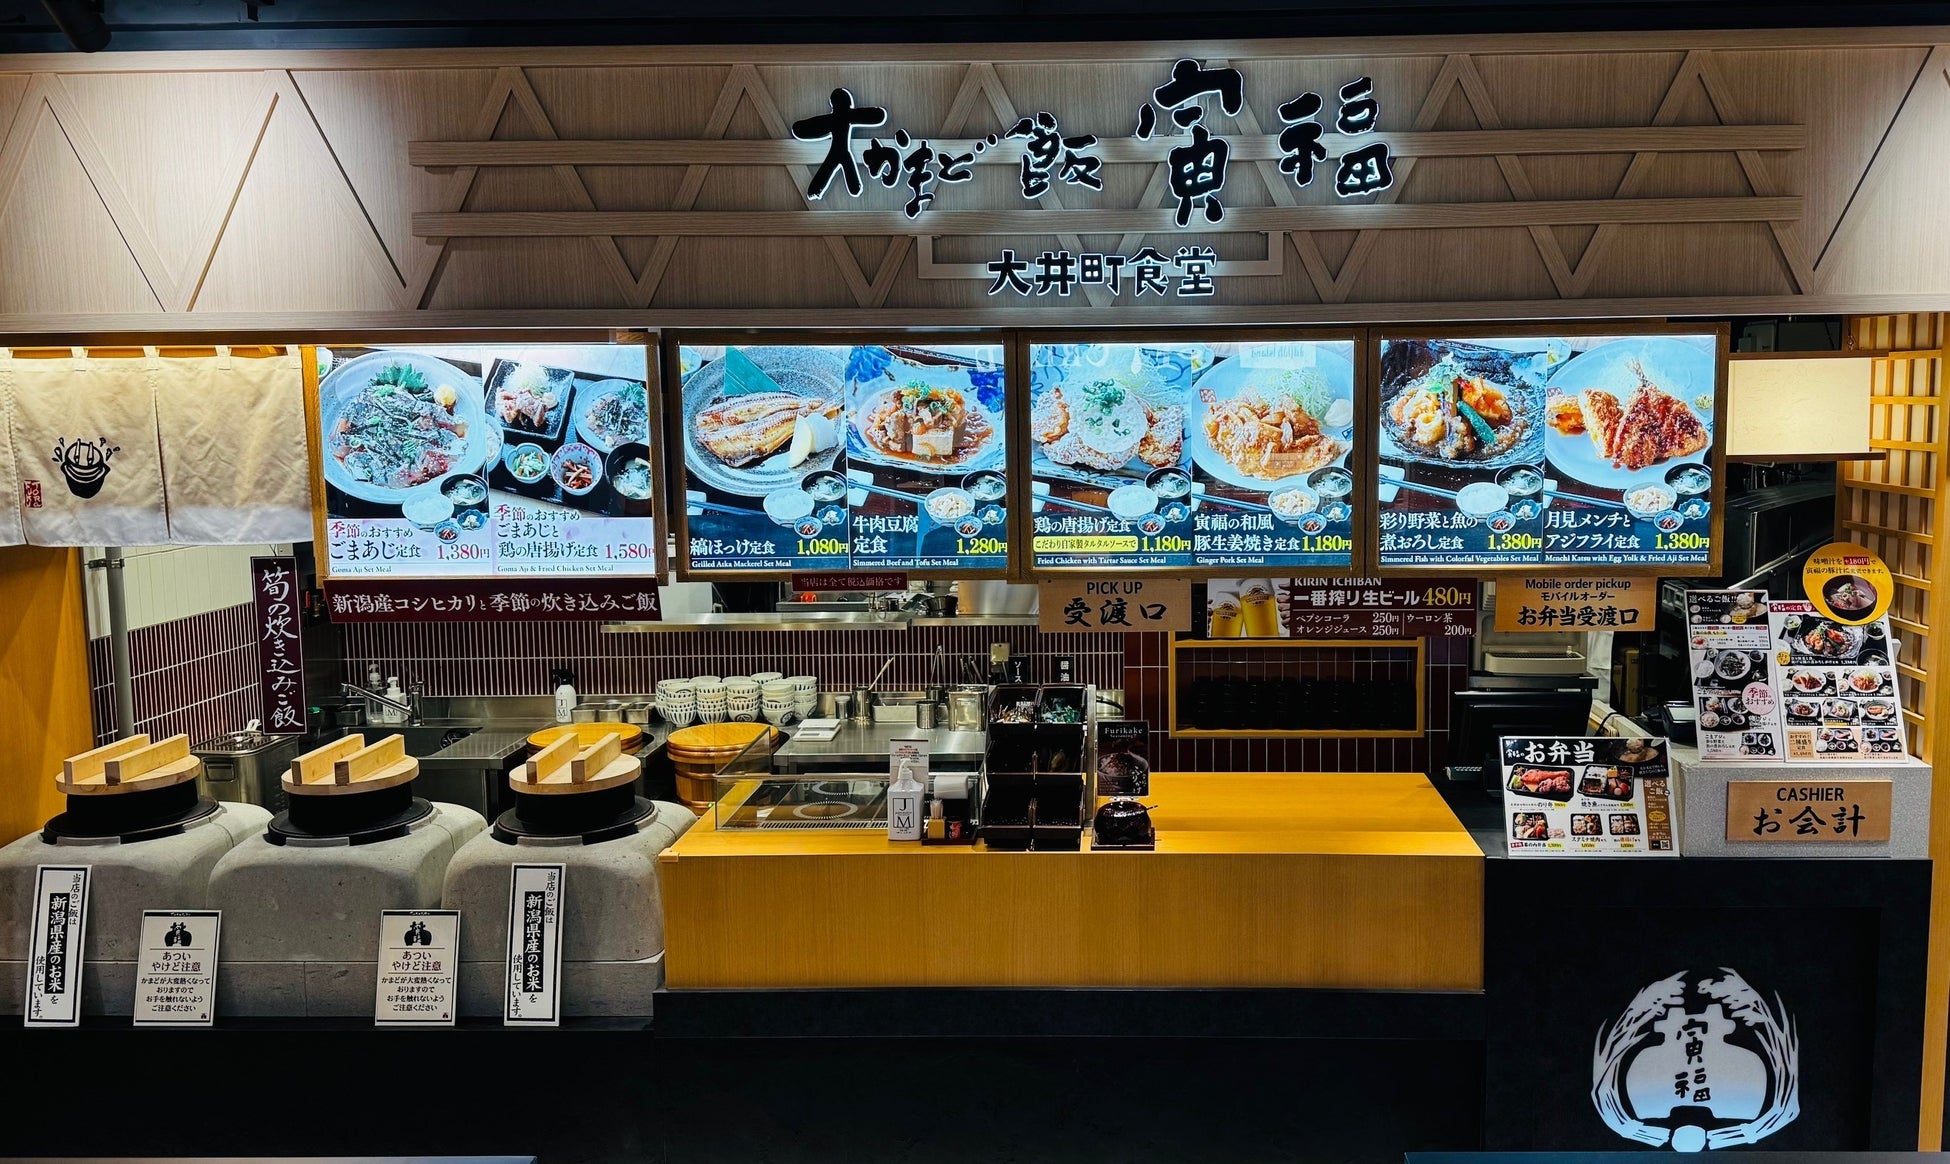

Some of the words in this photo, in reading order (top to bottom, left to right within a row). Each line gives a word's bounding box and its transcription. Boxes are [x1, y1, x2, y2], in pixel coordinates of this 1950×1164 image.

[986, 245, 1219, 298] 大井町食堂
[493, 503, 580, 522] 季節のおすすめ
[1379, 511, 1479, 530] 彩り野菜と魚の
[1544, 510, 1631, 529] 月見メンチと
[329, 520, 414, 539] 季節のおすすめ
[497, 522, 560, 540] ごまあじと
[852, 515, 919, 534] 牛肉豆腐
[1033, 516, 1131, 534] 鶏の唐揚げ定食
[1193, 513, 1275, 532] 寅福の和風
[329, 540, 422, 560] ごまあじ定食
[437, 542, 490, 560] 1,380円
[497, 540, 599, 560] 鶏の唐揚げ定食
[689, 538, 776, 557] 縞ほっけ定食
[796, 538, 848, 556] 1,080円
[852, 536, 888, 554] 定食
[956, 537, 1008, 555] 1,280円
[1141, 536, 1191, 553] 1,180円
[1193, 534, 1300, 552] 豚生姜焼き定食
[1301, 535, 1353, 552] 1,180円
[1379, 533, 1464, 550] 煮おろし定食
[1487, 533, 1541, 551] 1,380円
[1544, 532, 1640, 550] アジフライ定食
[1654, 532, 1710, 551] 1,380円
[1196, 557, 1219, 565] Ginger
[1609, 554, 1622, 563] Egg
[1087, 581, 1117, 595] PICK
[1120, 581, 1143, 595] UP
[1295, 578, 1328, 587] KIRIN
[1332, 578, 1382, 587] ICHIBAN
[1525, 578, 1562, 589] Mobile
[1564, 578, 1589, 589] order
[1591, 578, 1631, 591] pickup
[332, 591, 659, 616] 新潟産コシヒカリと季節の炊き込みご飯
[1294, 590, 1420, 608] 一番搾り生ビール
[1422, 586, 1471, 607] 480円
[1540, 591, 1615, 601] モバイルオーダー
[1063, 596, 1167, 628] 受渡口
[1296, 613, 1350, 623] ペプシコーラ
[1372, 612, 1399, 624] 250円
[1406, 612, 1453, 623] ウーロン茶
[1518, 604, 1640, 628] お弁当受渡口
[1295, 624, 1367, 635] オレンジジュース
[1372, 625, 1399, 636] 250円
[1444, 625, 1472, 636] 200円
[1104, 727, 1144, 735] Furikake
[1524, 740, 1595, 765] お弁当
[1776, 787, 1844, 801] CASHIER
[899, 798, 907, 812] J
[896, 815, 911, 828] M
[1753, 803, 1866, 838] お会計
[68, 872, 83, 926] 当店のご飯は
[543, 870, 558, 925] 当店のご飯は
[162, 951, 191, 961] あつい
[402, 950, 432, 960] あつい
[151, 961, 201, 972] やけど注意
[391, 960, 442, 972] やけど注意
[33, 955, 46, 1019] 使用しています。
[156, 986, 194, 994] おりますので
[396, 985, 435, 994] おりますので
[511, 953, 523, 1018] 使用しています。
[151, 1004, 197, 1013] ご注意ください
[392, 1003, 438, 1012] ご注意ください
